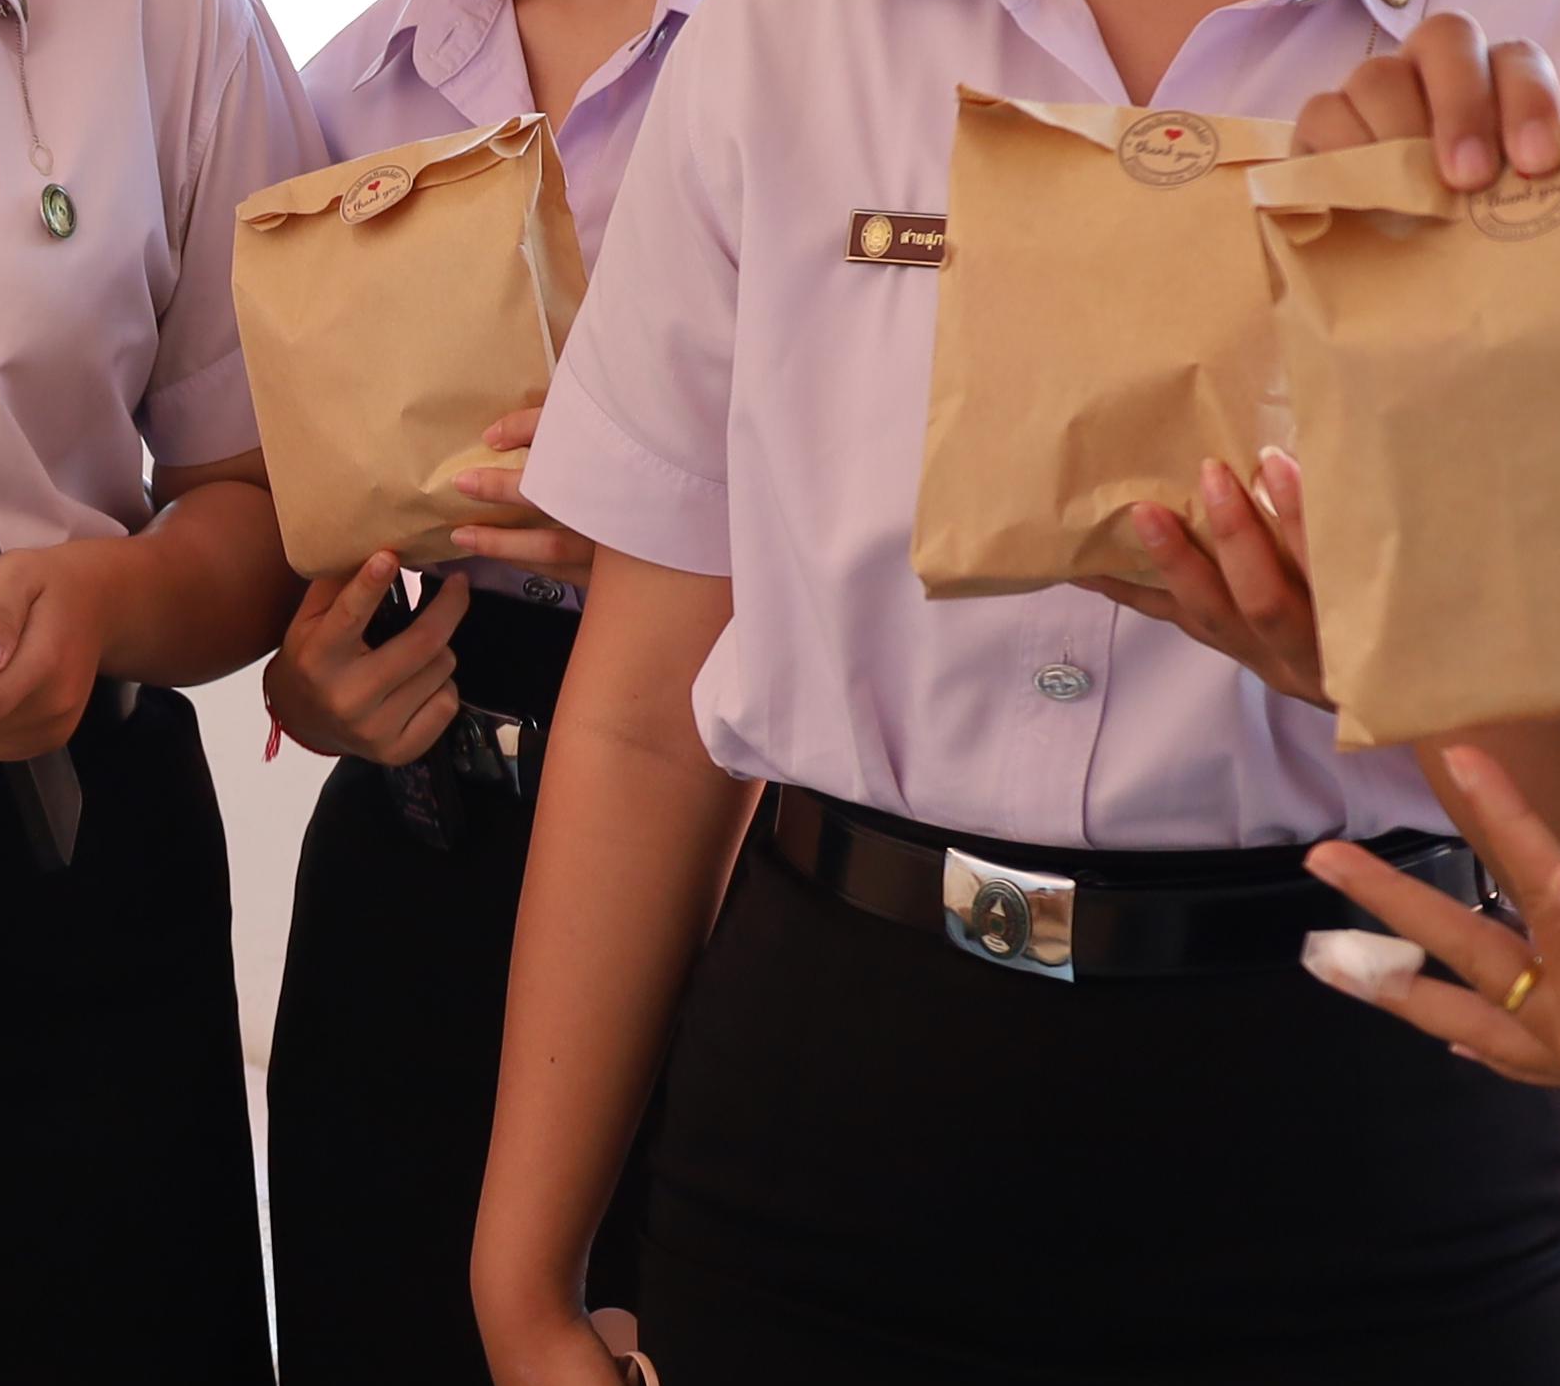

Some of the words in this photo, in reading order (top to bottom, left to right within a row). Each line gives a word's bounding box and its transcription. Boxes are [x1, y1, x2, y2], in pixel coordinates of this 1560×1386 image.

[354, 191, 380, 211] thank
[383, 185, 401, 199] you
[900, 228, 944, 251] สายสุภ
